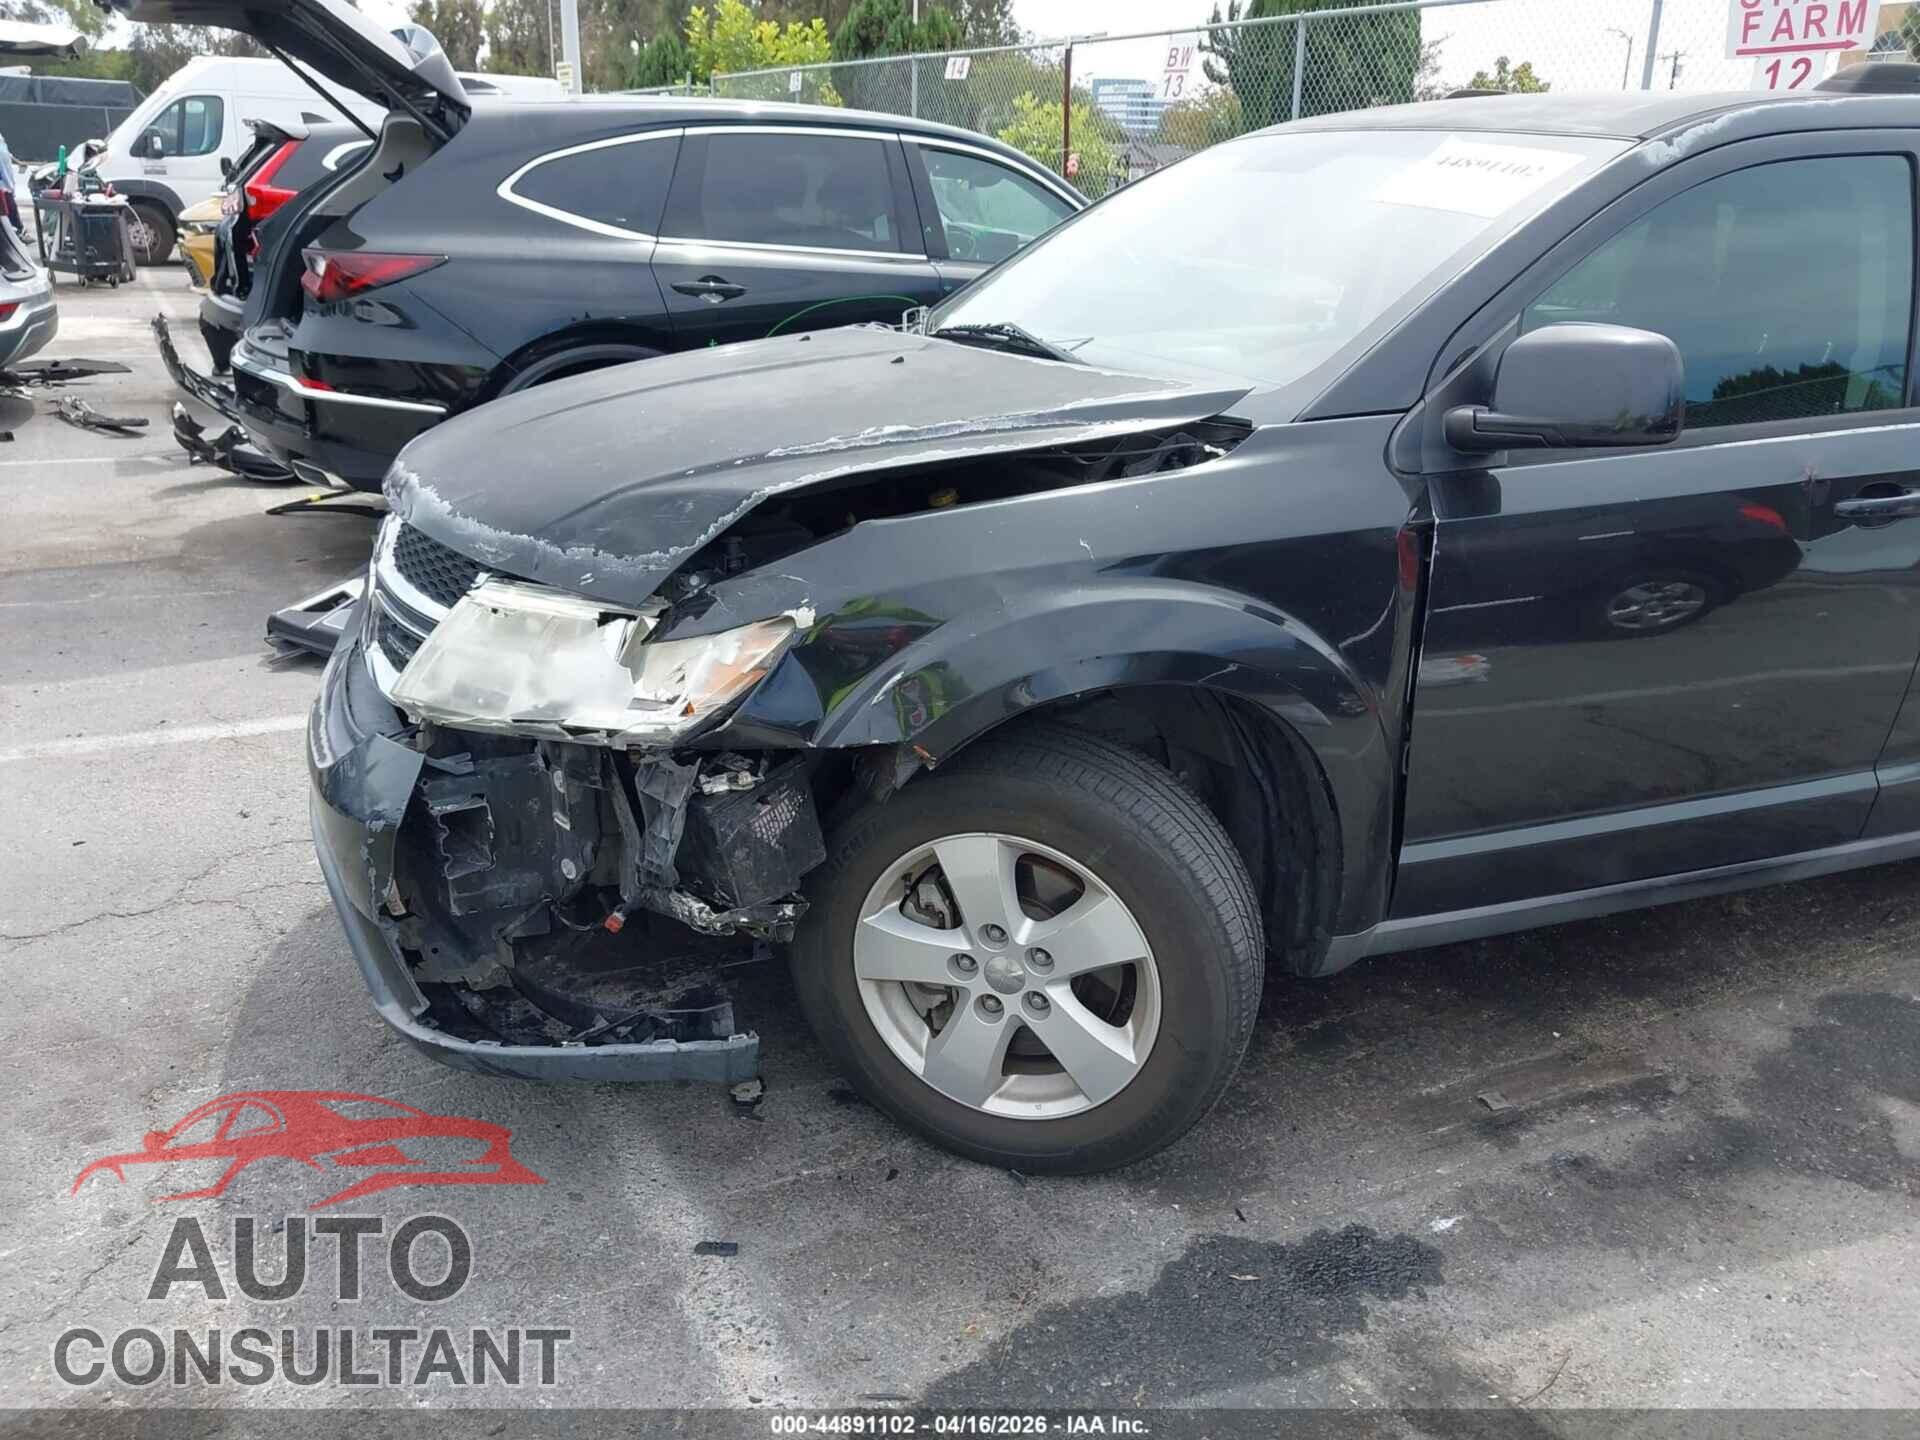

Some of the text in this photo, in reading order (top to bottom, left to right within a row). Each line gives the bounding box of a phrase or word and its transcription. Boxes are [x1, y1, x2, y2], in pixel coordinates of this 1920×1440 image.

[1742, 0, 1868, 44] FARM
[1167, 47, 1194, 68] BW
[1163, 74, 1184, 97] 13
[1765, 57, 1813, 90] 12
